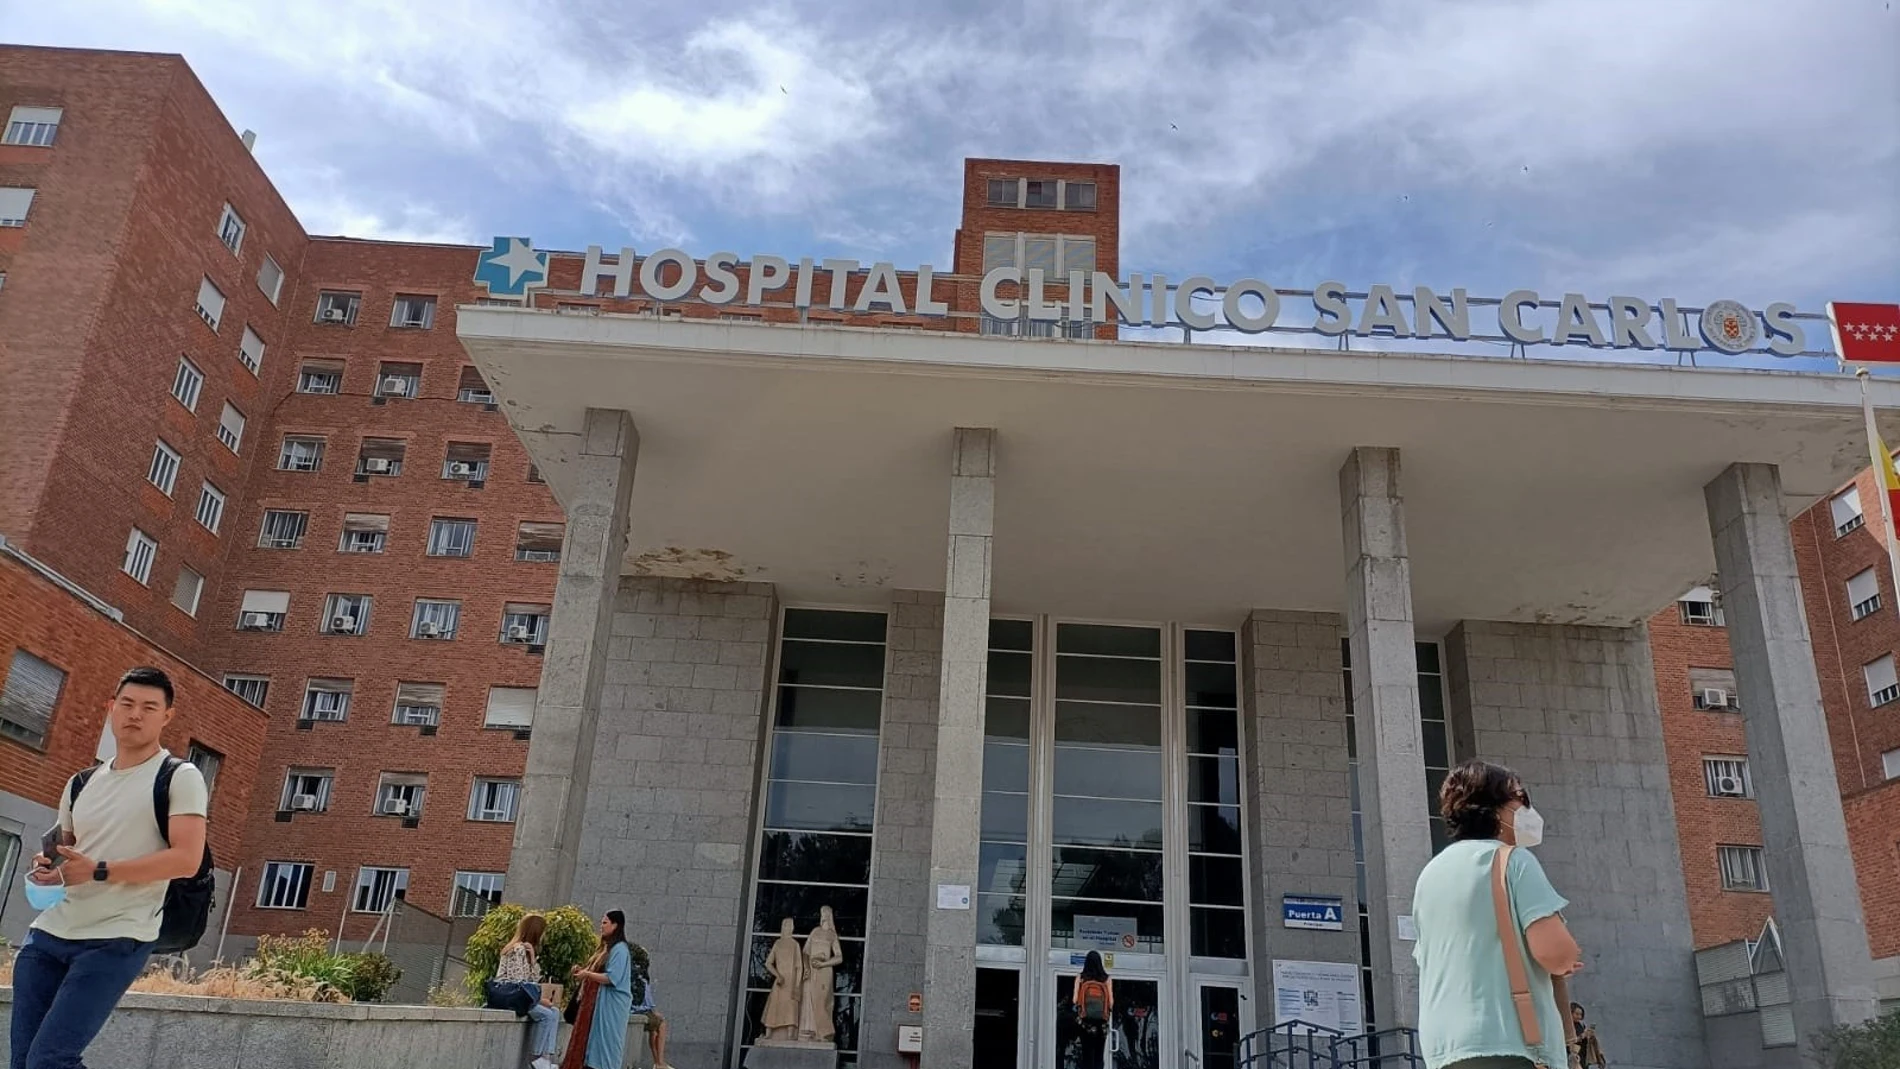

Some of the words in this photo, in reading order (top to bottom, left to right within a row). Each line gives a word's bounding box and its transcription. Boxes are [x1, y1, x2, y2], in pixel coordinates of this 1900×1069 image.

[580, 245, 949, 317] HOSPITAL
[979, 267, 1280, 334] CLINICO
[1313, 280, 1470, 341] SAN
[1499, 290, 1806, 358] CARLOS
[1288, 909, 1322, 920] Puerta
[1324, 907, 1338, 921] A
